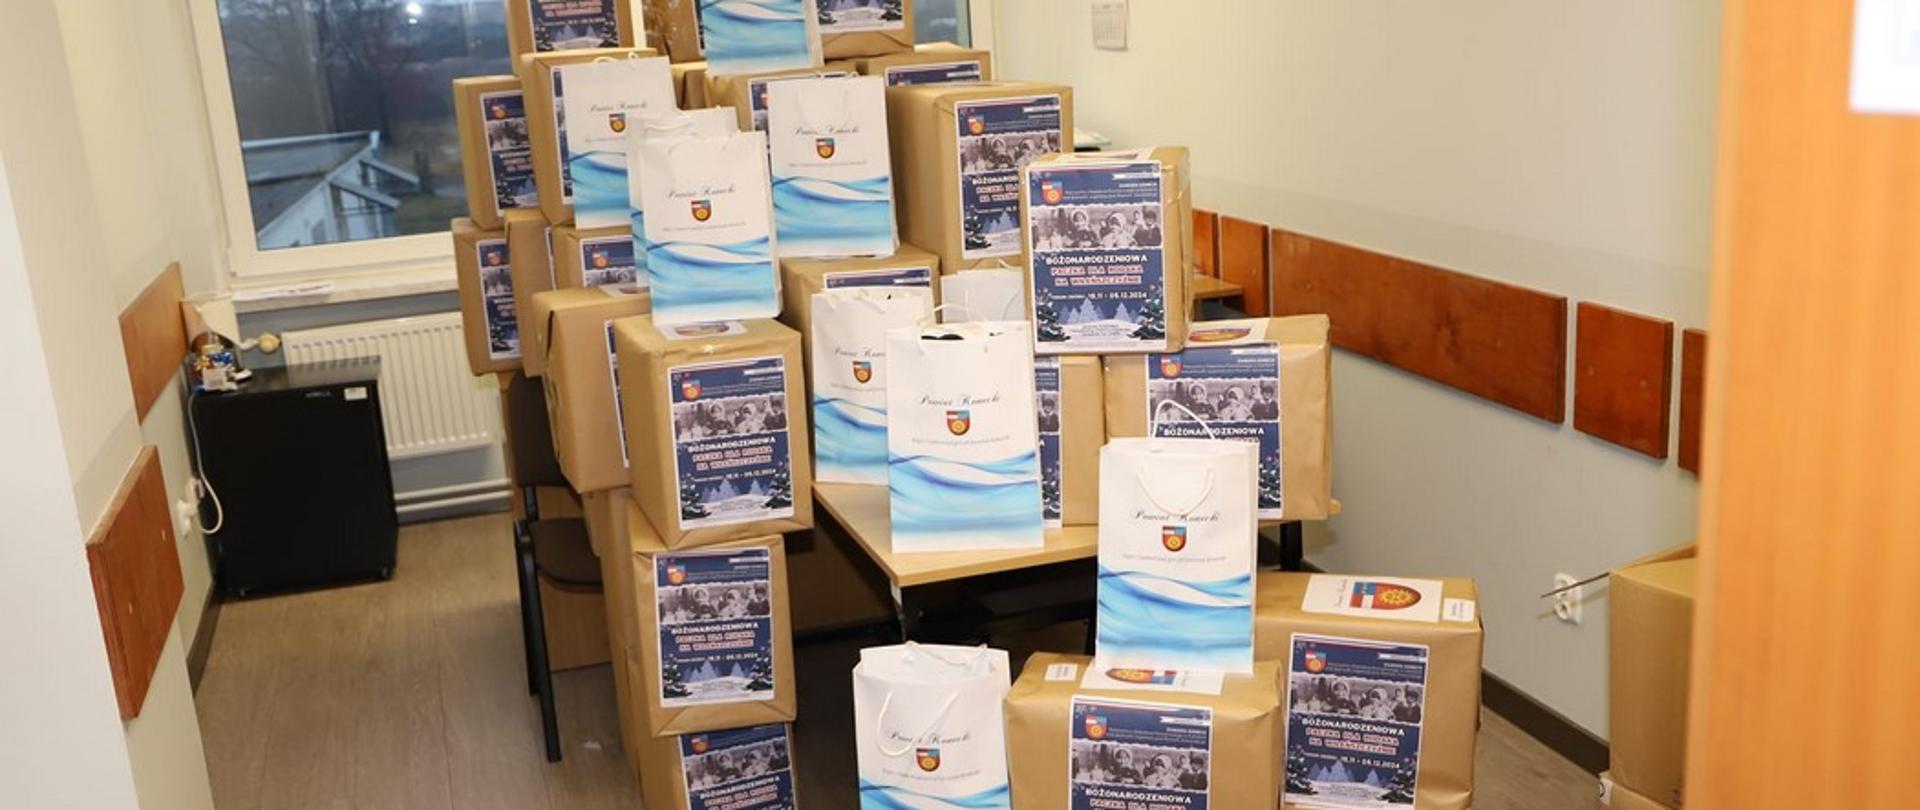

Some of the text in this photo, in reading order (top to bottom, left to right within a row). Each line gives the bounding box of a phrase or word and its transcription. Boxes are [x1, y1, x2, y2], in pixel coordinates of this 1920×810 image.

[1045, 254, 1148, 266] BOŻONARODZENIOWA
[1050, 266, 1086, 276] PACZKA
[1087, 265, 1106, 275] DLA
[1302, 718, 1405, 736] BOŻONARODZENIOWA
[1085, 788, 1192, 804] BOŻONARODZENIOWA
